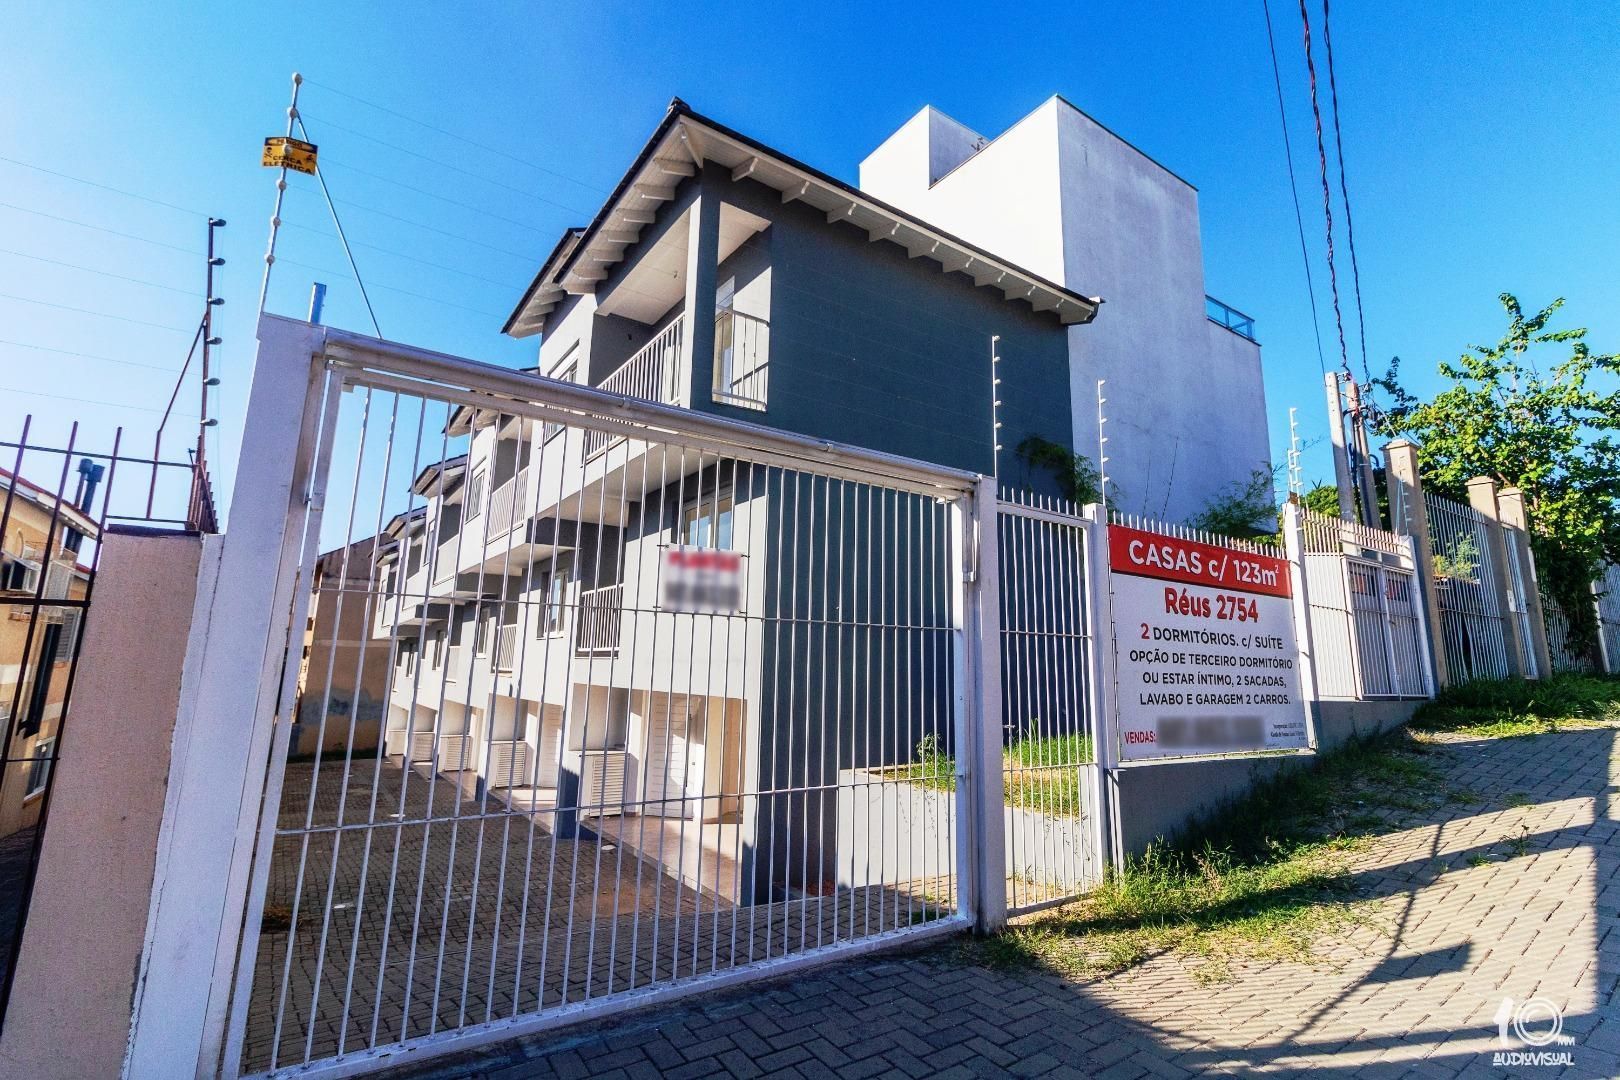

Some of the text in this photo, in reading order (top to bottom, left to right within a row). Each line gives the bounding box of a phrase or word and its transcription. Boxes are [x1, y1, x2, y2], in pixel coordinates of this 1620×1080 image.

[1128, 539, 1202, 575] CASAS
[1208, 555, 1228, 582] c/
[1164, 587, 1259, 623] Réus 2754
[1140, 623, 1283, 650] 2 DORMITÓRIOS. c/ SUÍTE
[1129, 648, 1293, 670] OPÇÃO DE TERCEIRO DORMITÓRIO
[1142, 671, 1287, 689] OU ESTAR ÍNTIMO, 2 SACADAS,
[1139, 693, 1291, 705] LAVABO E GARAGEM 2 CARROS.
[1124, 730, 1157, 744] VENDAS:
